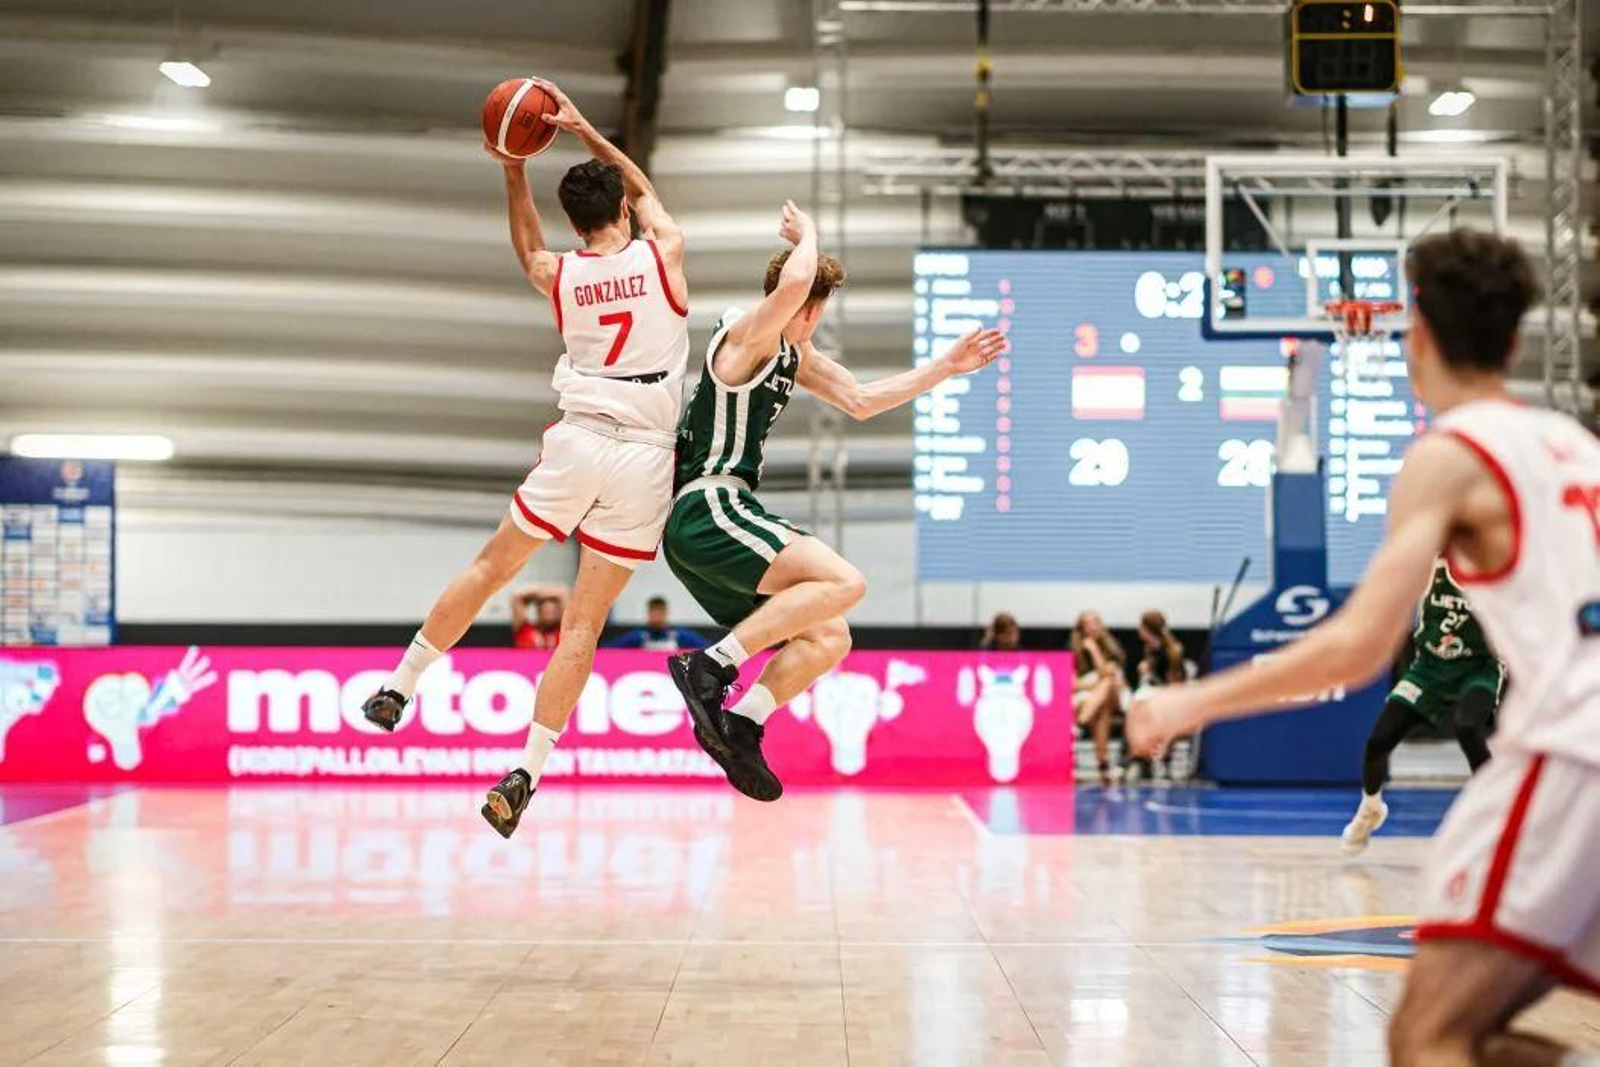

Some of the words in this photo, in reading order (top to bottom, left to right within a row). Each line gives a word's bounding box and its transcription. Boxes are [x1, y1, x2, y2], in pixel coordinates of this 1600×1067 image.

[574, 275, 647, 307] GONZÁLEZ
[598, 311, 633, 366] 7
[1178, 366, 1204, 402] 2
[227, 660, 696, 735] motone
